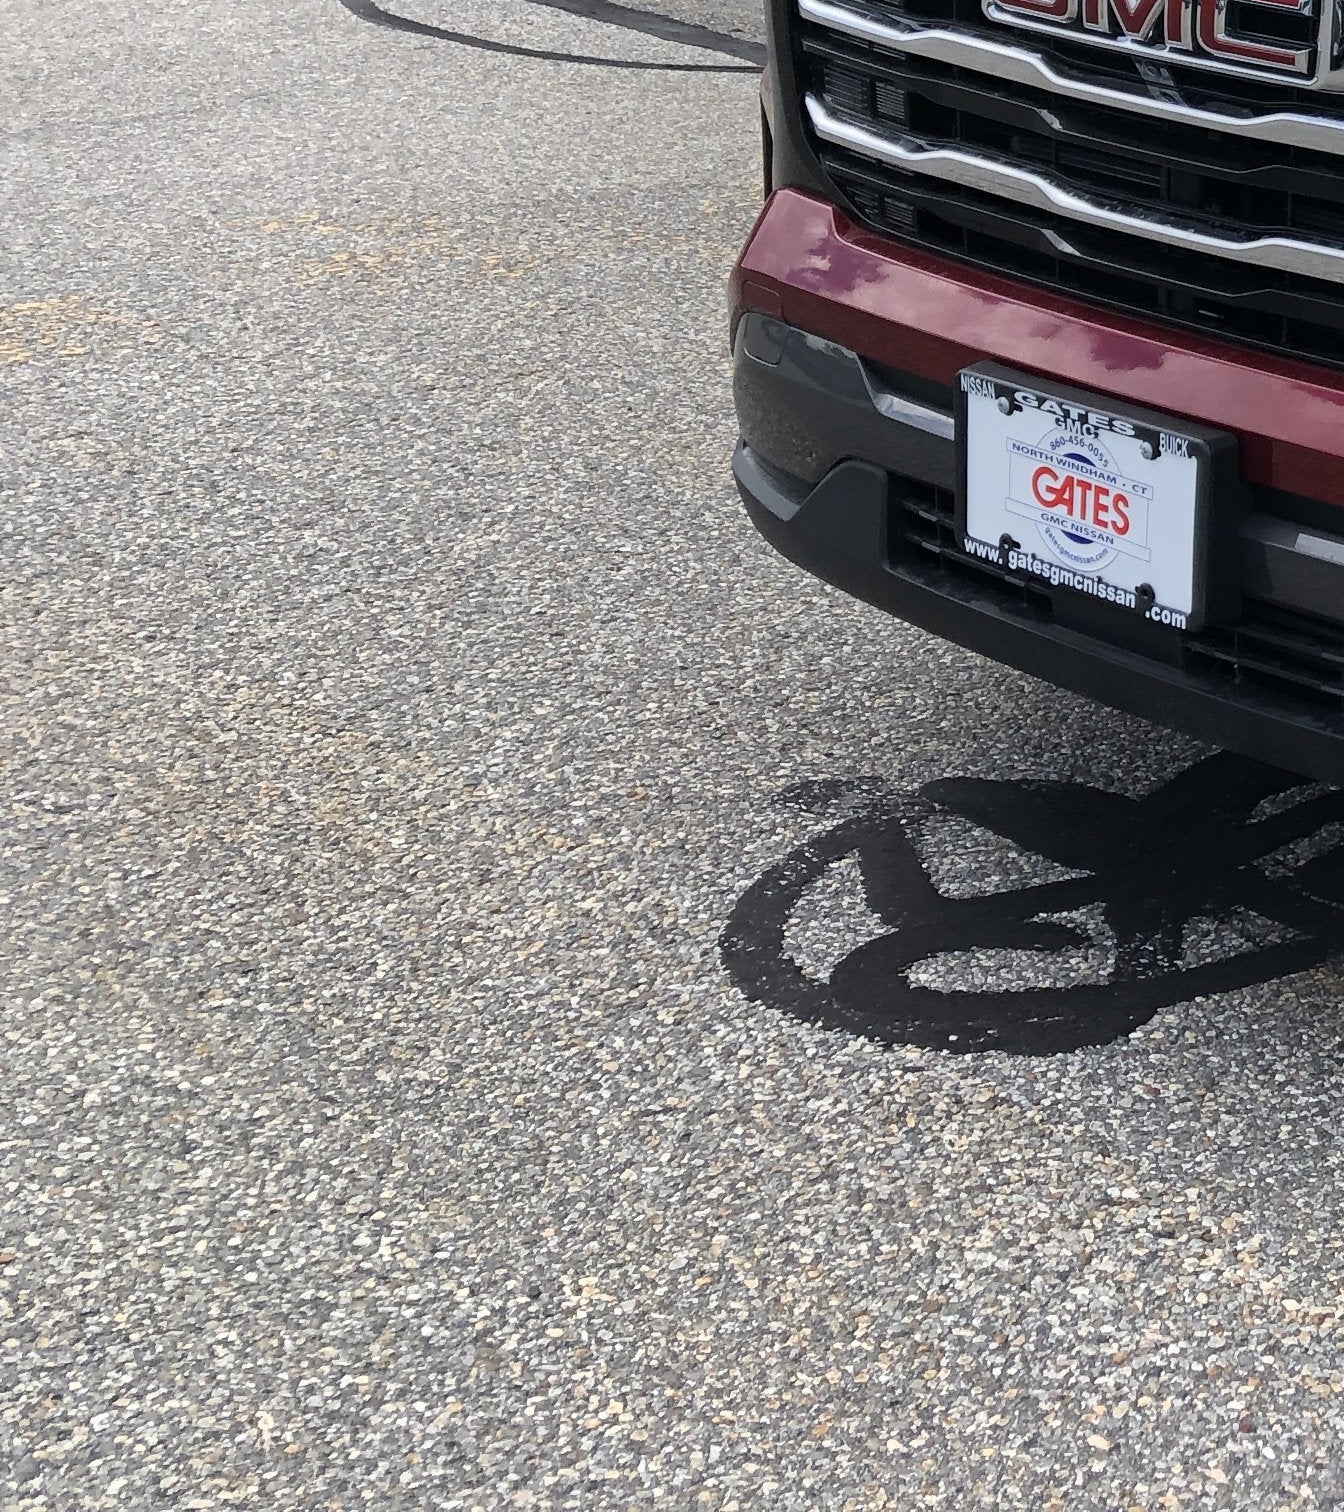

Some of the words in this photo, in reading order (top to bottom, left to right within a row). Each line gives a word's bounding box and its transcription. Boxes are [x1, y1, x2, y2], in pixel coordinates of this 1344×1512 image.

[960, 374, 996, 400] NISSAN
[1014, 391, 1136, 437] GATES
[1054, 416, 1098, 439] GMC
[1049, 435, 1110, 468] 860-456-0055
[1159, 432, 1190, 459] BUICK
[1012, 443, 1054, 463] NORTH
[1056, 456, 1118, 485] WINDHAM
[1132, 484, 1148, 495] CT
[1032, 466, 1130, 536] GATES
[1041, 512, 1069, 529] GMC
[1070, 523, 1114, 545] NISSAN
